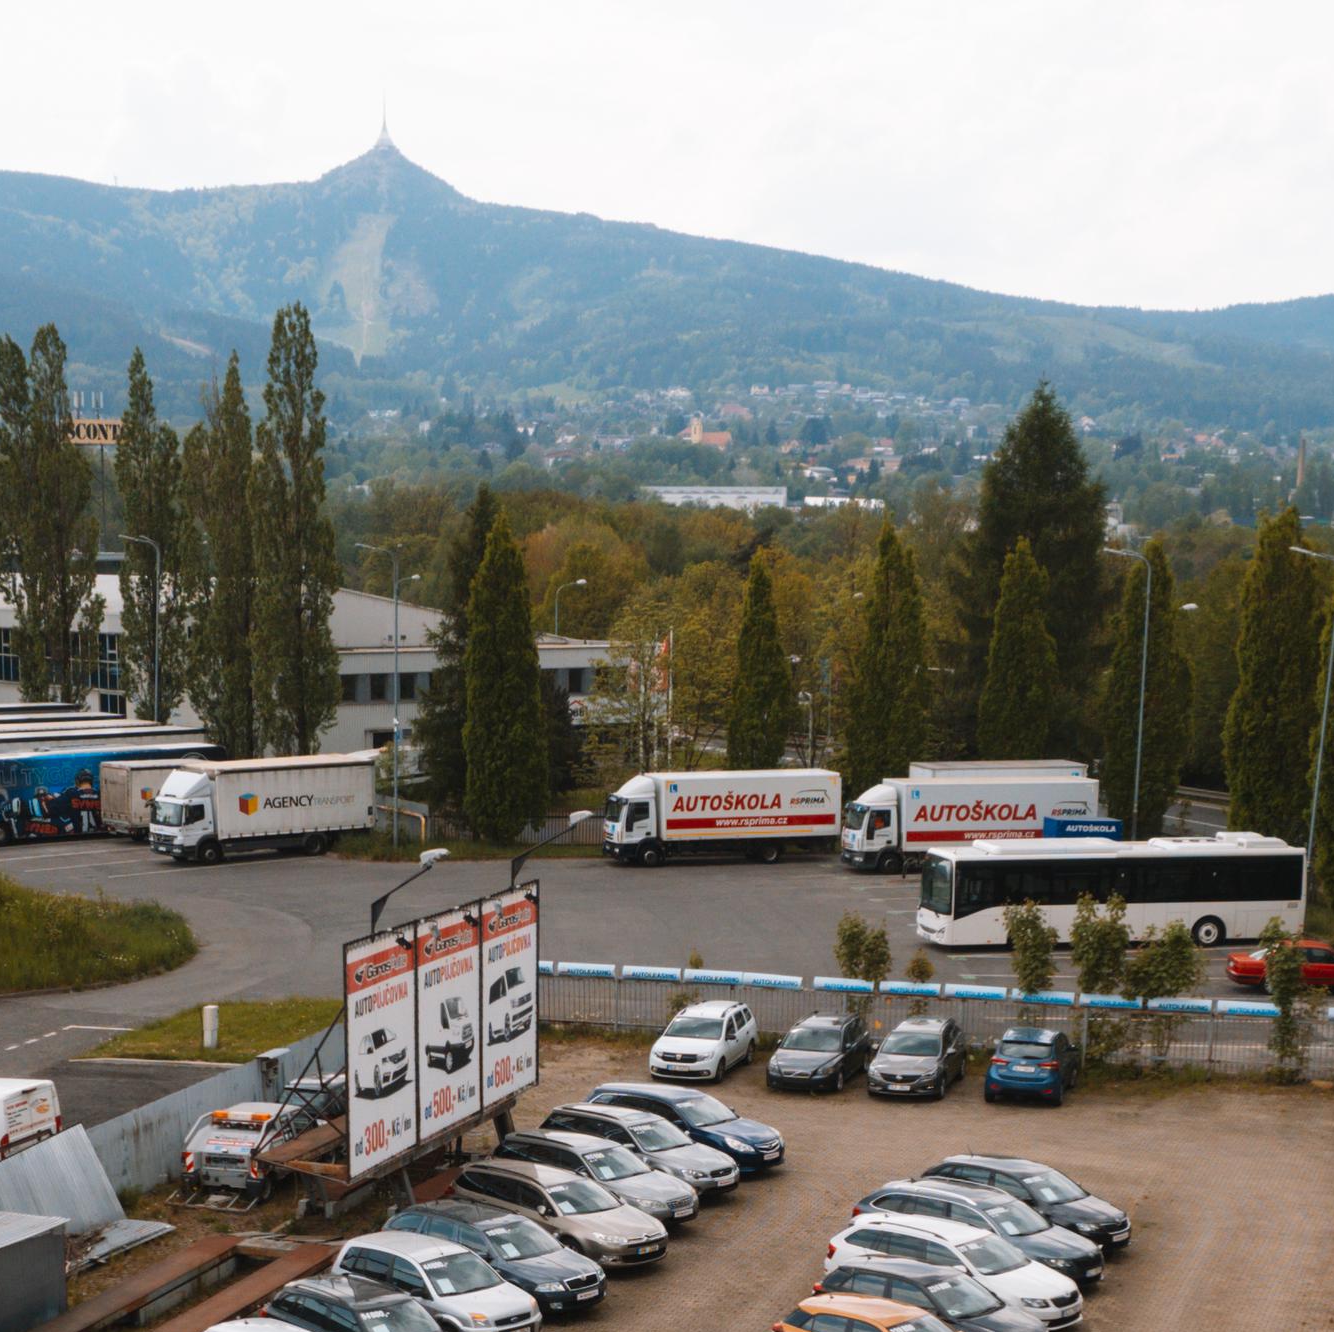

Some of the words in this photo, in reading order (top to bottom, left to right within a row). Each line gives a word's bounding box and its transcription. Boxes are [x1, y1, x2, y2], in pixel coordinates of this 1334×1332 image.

[263, 794, 314, 810] AGENCY
[672, 790, 782, 813] AUTOŠKOLA
[914, 800, 1037, 823] AUTOŠKOLA
[715, 816, 788, 827] www.rsprima.cz
[1065, 823, 1117, 833] AUTOŠKOLA
[963, 829, 1036, 840] www.rsprima.cz
[355, 1137, 364, 1156] od
